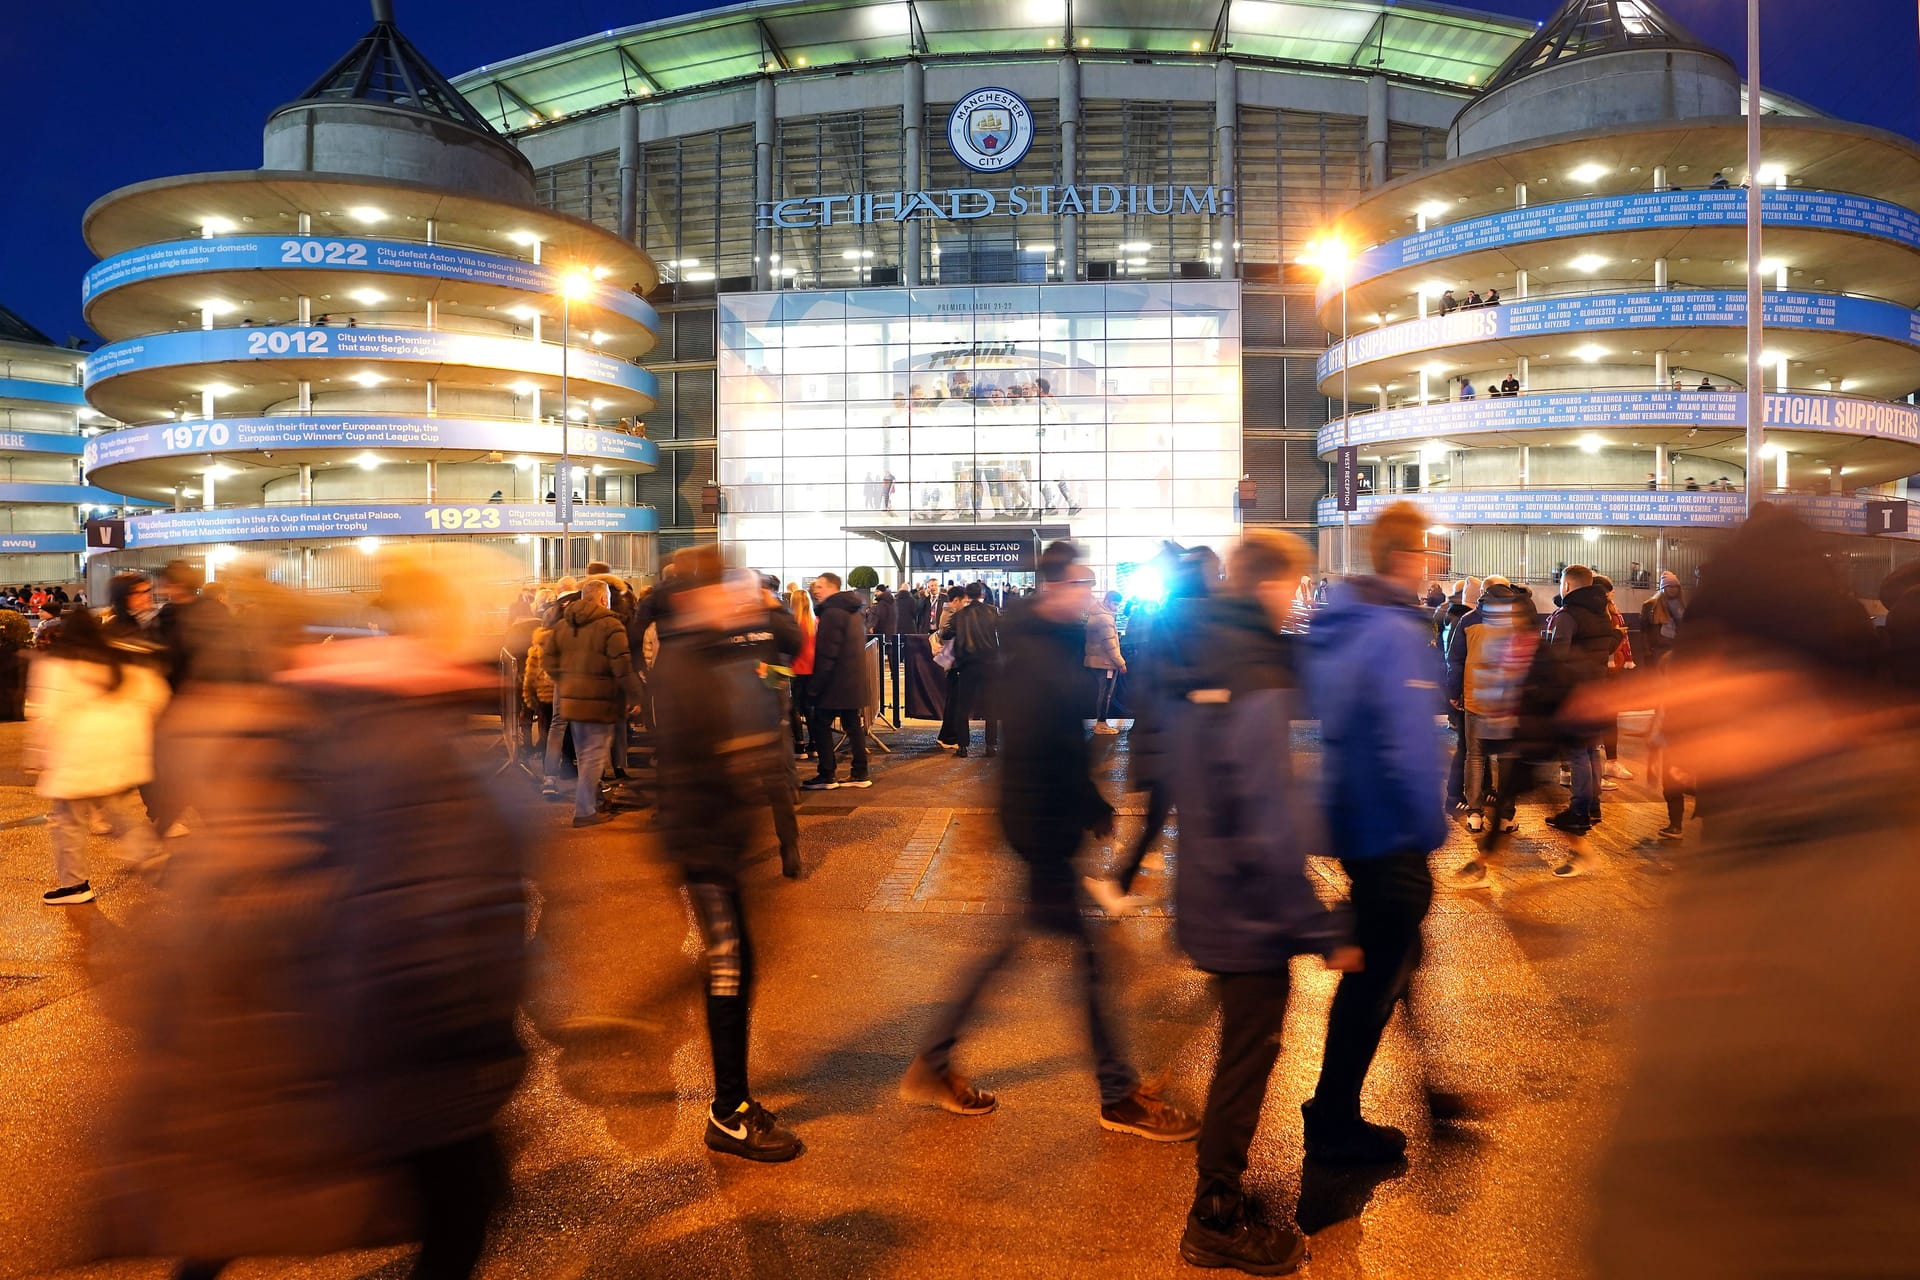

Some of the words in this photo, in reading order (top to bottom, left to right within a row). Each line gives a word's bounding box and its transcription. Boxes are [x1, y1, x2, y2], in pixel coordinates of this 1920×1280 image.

[957, 94, 1024, 120] MANCHESTER
[772, 189, 996, 228] ETIHAD
[1009, 185, 1217, 215] STADIUM
[1590, 202, 1604, 210] CITY
[1605, 200, 1623, 209] BLUES
[1634, 197, 1659, 205] ATLANTA
[151, 250, 164, 259] side
[166, 249, 173, 257] to
[174, 248, 187, 256] win
[217, 244, 258, 252] domestic
[281, 241, 367, 265] 2022
[378, 248, 396, 258] City
[399, 250, 427, 259] defeat
[430, 253, 456, 262] Aston
[457, 257, 476, 266] Villa
[477, 259, 486, 267] to
[487, 263, 514, 272] secure
[516, 266, 527, 275] the
[378, 257, 411, 268] League
[413, 261, 431, 270] title
[432, 262, 473, 277] following
[474, 270, 505, 280] another
[507, 275, 540, 286] dramatic
[938, 303, 966, 311] PREMIER
[248, 331, 329, 354] 2012
[338, 333, 357, 342] City
[395, 336, 430, 345] Premier
[1358, 319, 1438, 360] SUPPORTERS
[1441, 311, 1498, 340] CLUBS
[338, 343, 358, 351] that
[381, 344, 410, 354] Sergio
[1763, 396, 1831, 427] FFICIAL
[1834, 400, 1918, 438] SUPPORTERS
[162, 423, 229, 450] 1970
[238, 424, 256, 433] City
[276, 423, 297, 431] their
[299, 422, 318, 431] first
[343, 423, 388, 432] European
[389, 424, 421, 433] trophy,
[423, 424, 438, 432] the
[239, 434, 281, 443] European
[283, 433, 301, 442] Cup
[303, 432, 344, 441] Winners'
[346, 433, 364, 441] Cup
[366, 432, 383, 440] and
[386, 433, 419, 441] League
[421, 433, 439, 442] Cup
[138, 522, 149, 531] City
[149, 520, 171, 529] defeat
[172, 519, 196, 528] Bolton
[197, 517, 240, 526] Wanderers
[242, 515, 249, 523] in
[251, 515, 265, 523] the
[267, 514, 279, 522] FA
[281, 514, 298, 523] Cup
[300, 513, 320, 521] final
[334, 512, 366, 522] Crystal
[425, 508, 501, 530] 1923
[1882, 509, 1893, 529] T
[99, 527, 111, 544] V
[170, 528, 181, 537] the
[182, 527, 198, 536] first
[199, 524, 249, 536] Manchester
[251, 523, 269, 533] side
[281, 524, 298, 532] win
[308, 522, 334, 532] major
[336, 522, 368, 531] trophy
[2, 540, 36, 549] away
[932, 543, 961, 552] COLIN
[989, 543, 1020, 551] STAND
[934, 554, 961, 562] WEST
[964, 553, 1019, 562] RECEPTION
